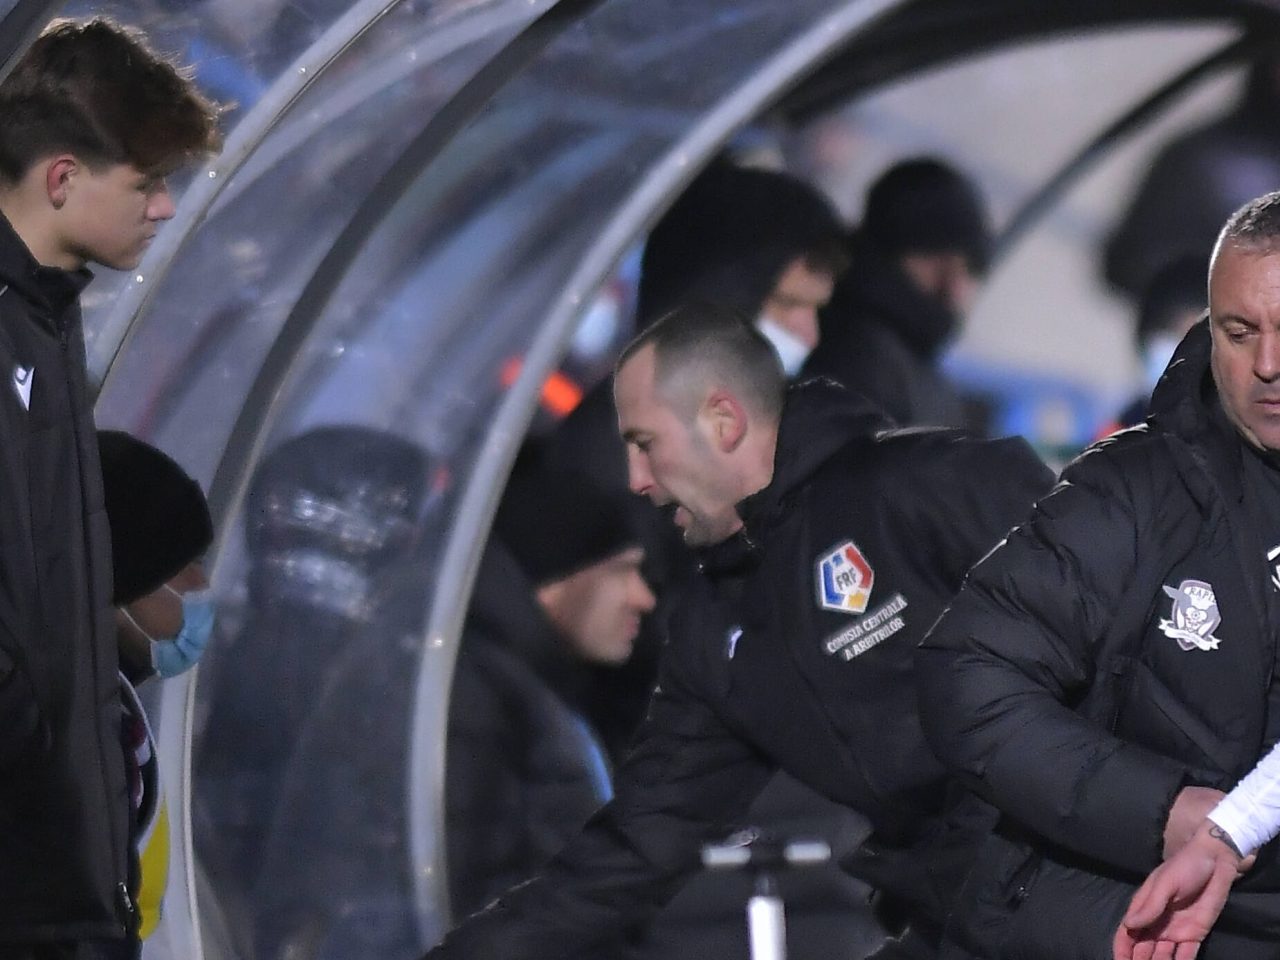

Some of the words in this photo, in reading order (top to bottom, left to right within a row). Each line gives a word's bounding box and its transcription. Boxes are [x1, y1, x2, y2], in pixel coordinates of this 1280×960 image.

[835, 567, 857, 591] FRF
[826, 625, 864, 654] COMISIA
[852, 617, 906, 656] ARBITRILOR
